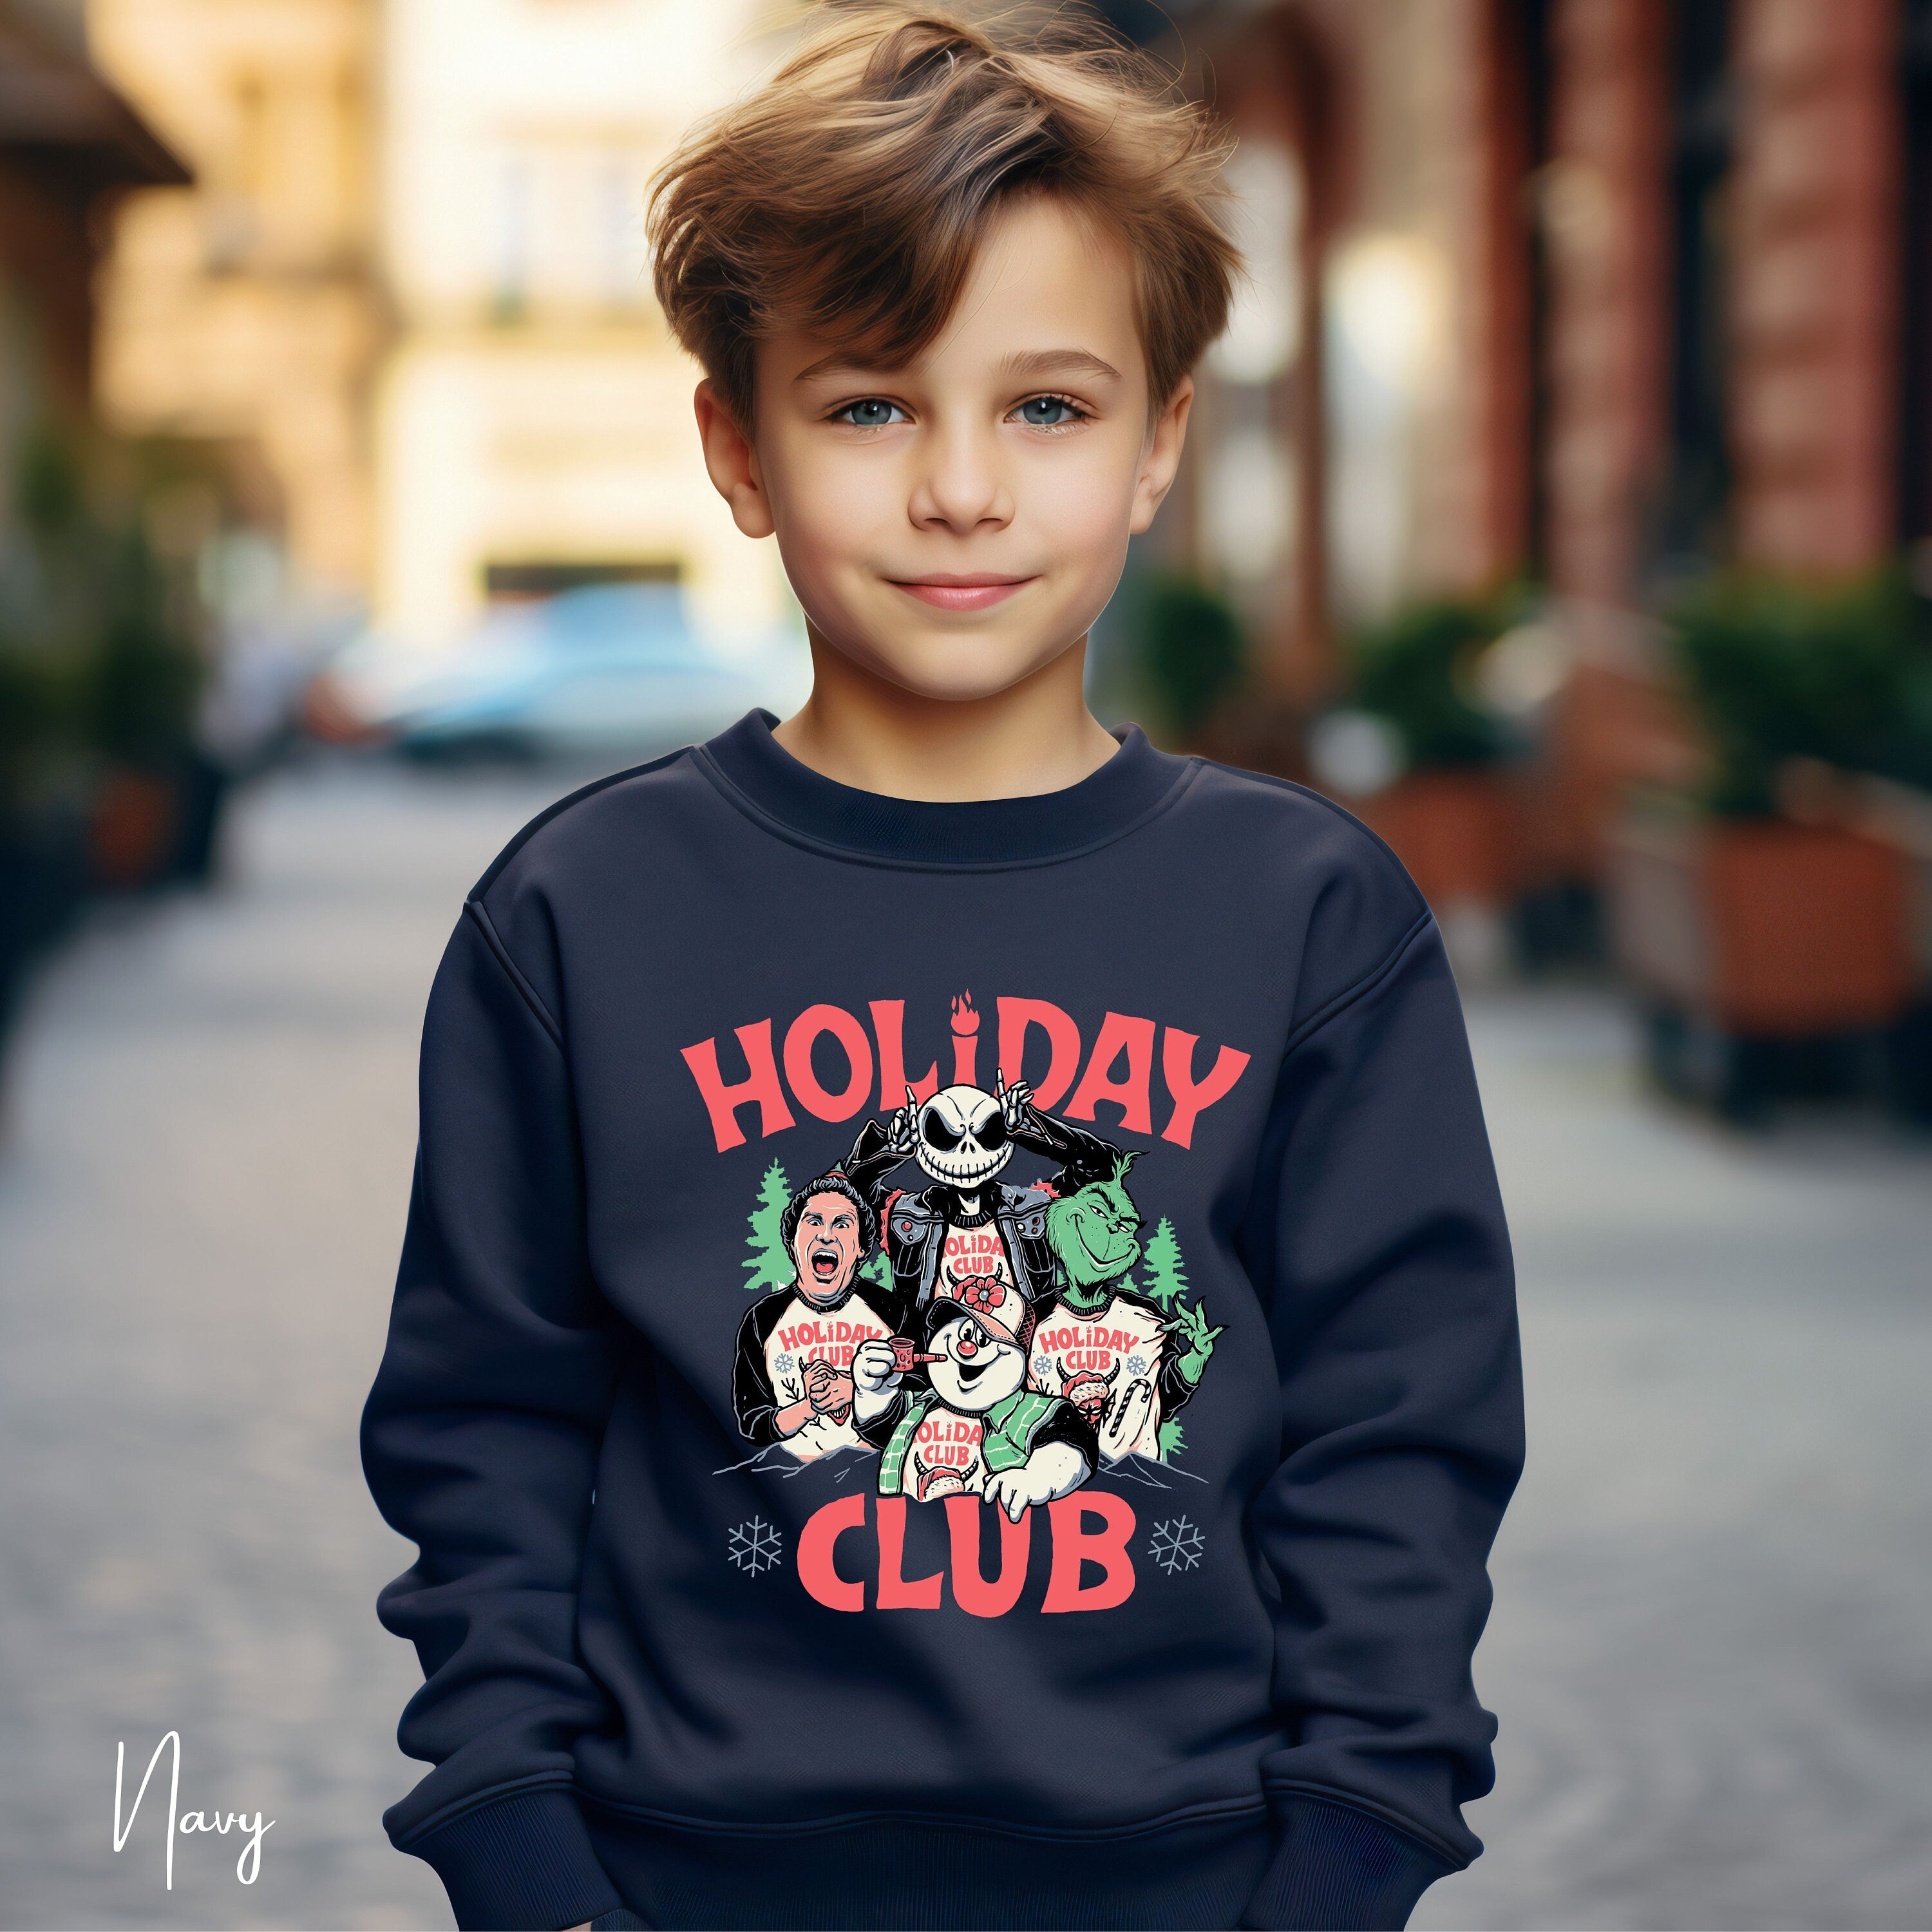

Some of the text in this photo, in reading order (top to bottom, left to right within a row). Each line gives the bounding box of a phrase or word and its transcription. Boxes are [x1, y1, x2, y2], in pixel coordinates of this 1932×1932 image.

[953, 1256, 994, 1274] CLUB
[808, 1345, 854, 1367] CLUB
[1066, 1350, 1111, 1370] CLUB
[923, 1444, 969, 1466] CLUB
[797, 1492, 1136, 1618] CLUB
